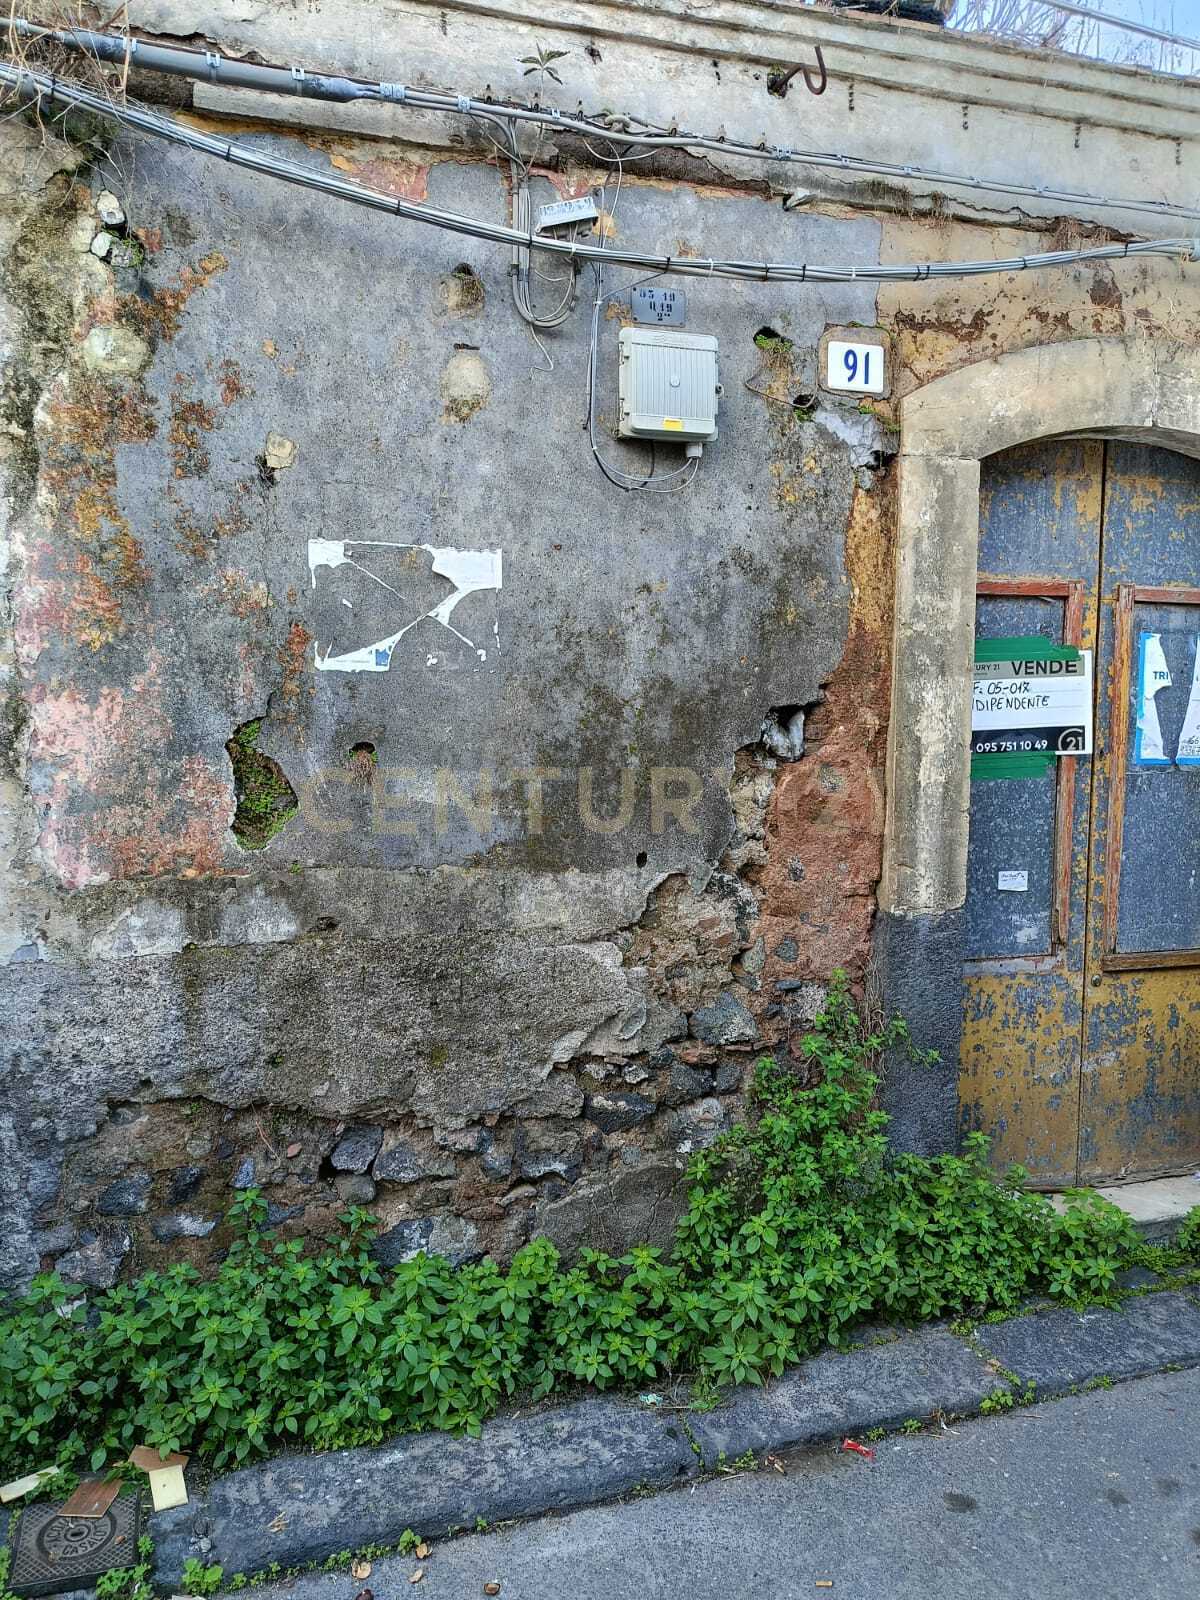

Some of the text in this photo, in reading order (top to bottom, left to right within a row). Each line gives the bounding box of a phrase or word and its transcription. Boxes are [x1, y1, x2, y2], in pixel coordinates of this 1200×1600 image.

[844, 349, 869, 384] 91
[974, 663, 991, 671] URY
[1011, 660, 1078, 675] VENDE
[976, 739, 1048, 753] 095 751 10 49
